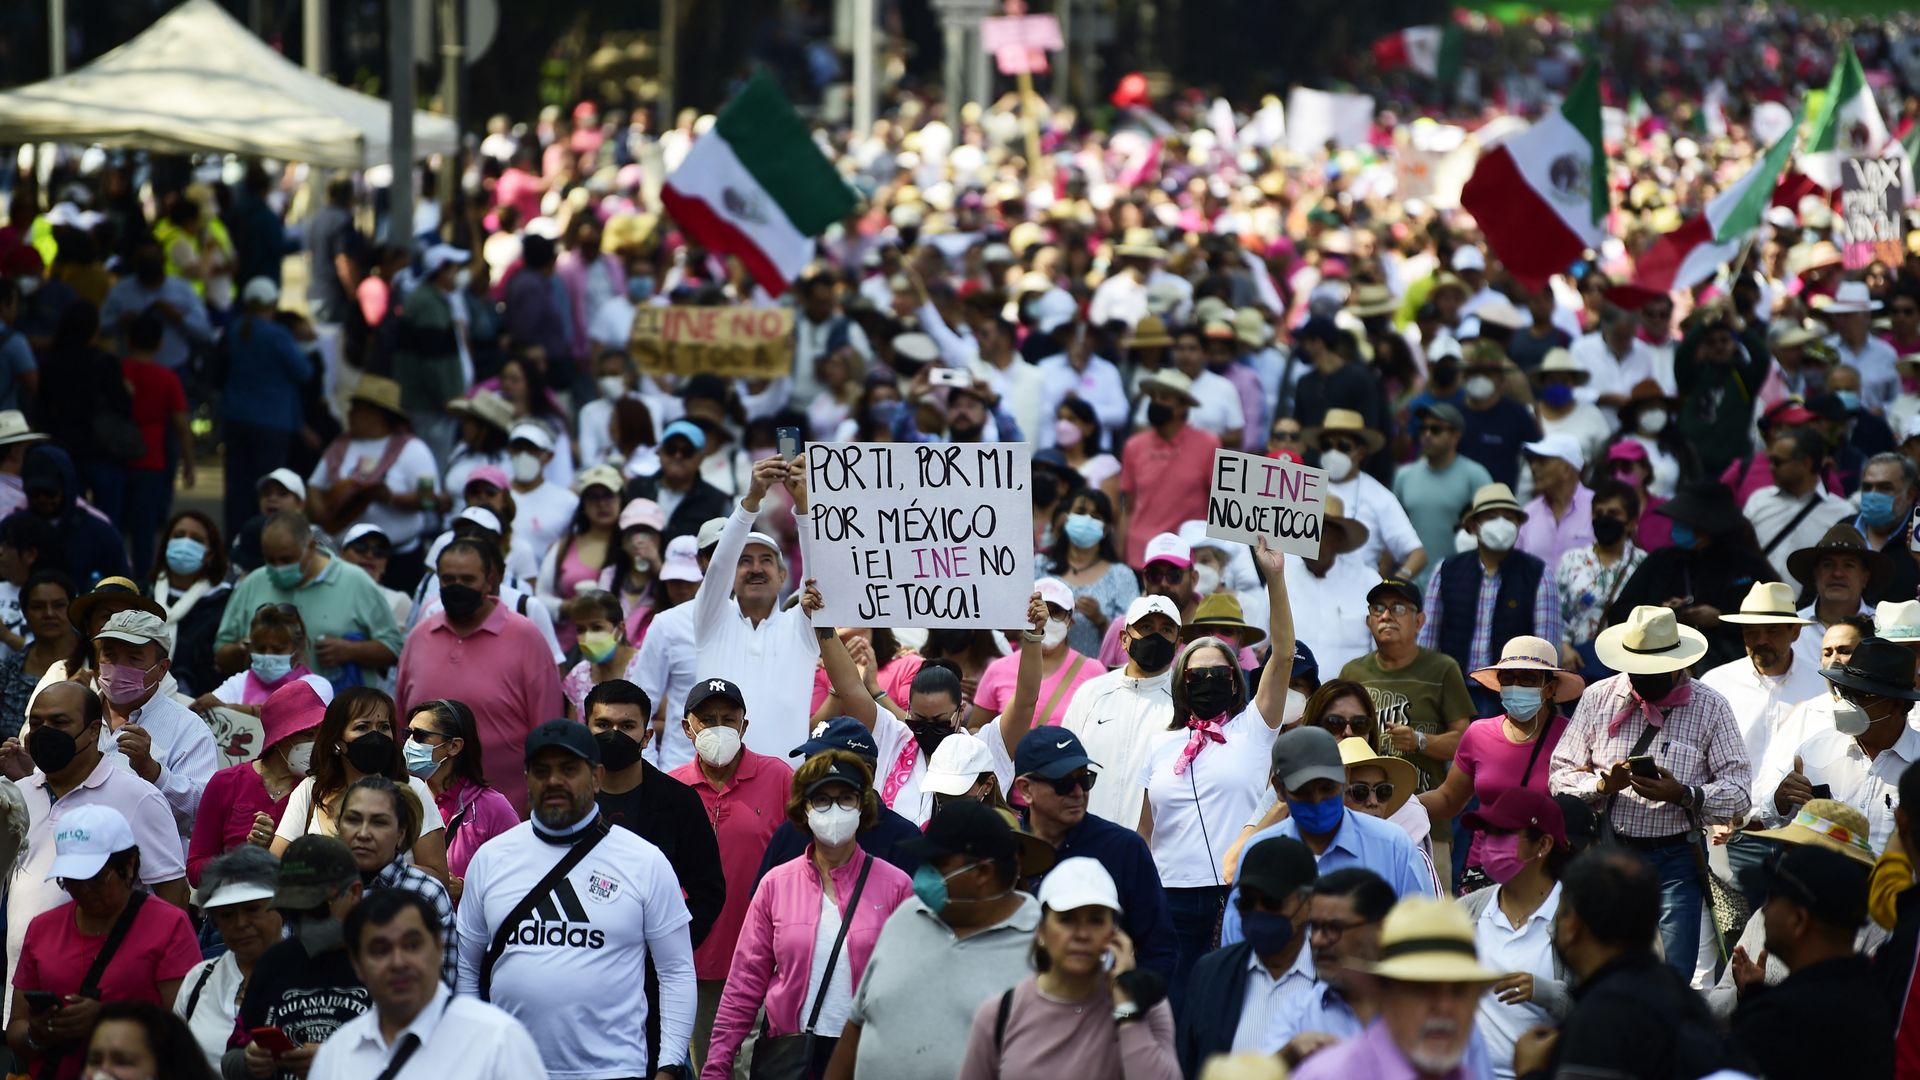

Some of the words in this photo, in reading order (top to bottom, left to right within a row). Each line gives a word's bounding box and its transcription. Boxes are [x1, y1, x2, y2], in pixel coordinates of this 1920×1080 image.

[662, 309, 718, 342] INE
[731, 311, 783, 338] NO
[809, 444, 867, 493] POR
[869, 447, 905, 491] TI,
[914, 445, 972, 488] POR
[977, 448, 1023, 491] MI,
[1257, 464, 1320, 503] INE
[811, 503, 865, 542] POR
[878, 498, 997, 544] MÉXICO
[1209, 496, 1243, 529] NO
[1245, 505, 1270, 533] SE
[911, 546, 971, 579] INE
[980, 545, 1016, 576] NO
[858, 583, 891, 620] SE
[847, 739, 869, 749] England
[278, 995, 367, 1017] GUANAJUATO
[303, 1008, 318, 1016] OLD
